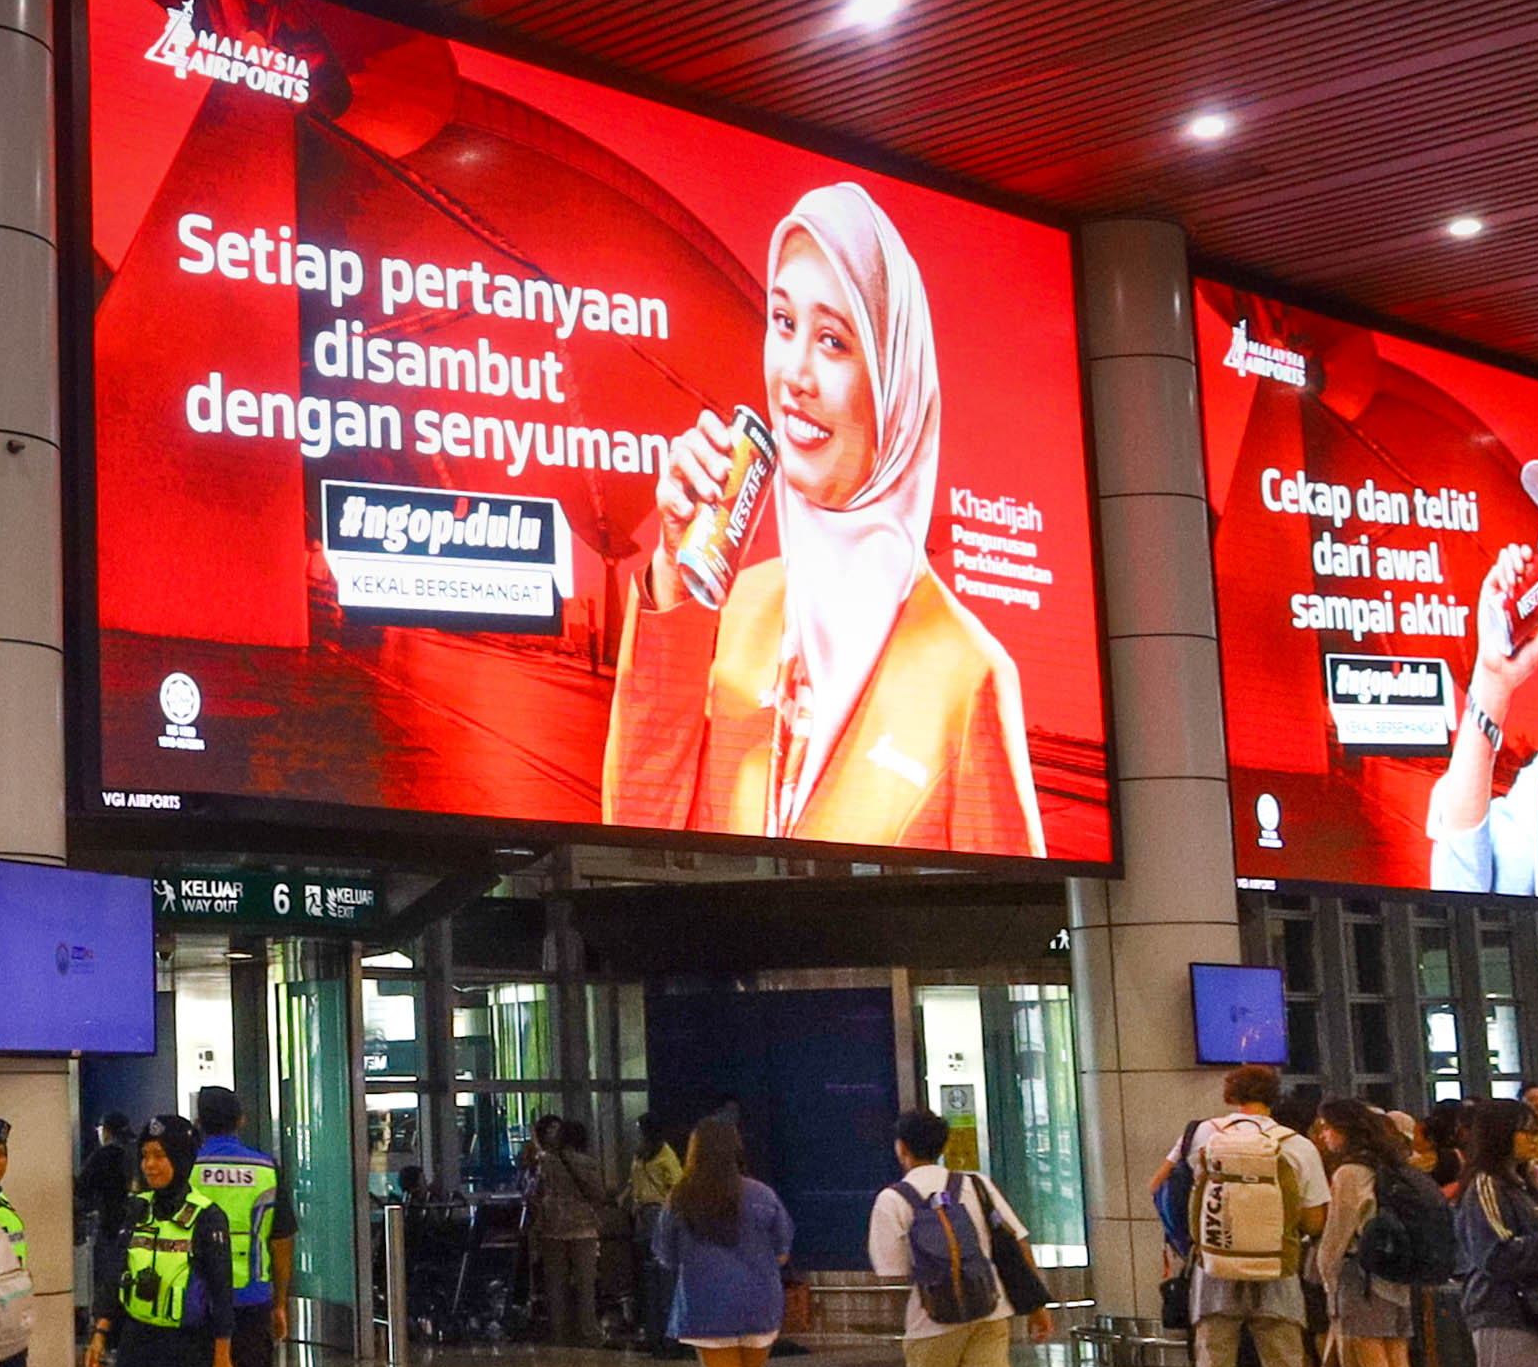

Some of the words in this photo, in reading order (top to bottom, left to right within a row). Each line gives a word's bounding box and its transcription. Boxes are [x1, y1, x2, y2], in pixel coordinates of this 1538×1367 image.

[187, 50, 310, 104] AIRPORTS
[198, 29, 310, 79] MALAYSIA
[177, 212, 364, 307] Setiap
[380, 255, 669, 340] pertanyaan
[313, 320, 565, 403] disambut
[185, 371, 402, 459] dengan
[415, 407, 671, 477] senyuman
[339, 496, 542, 553] #ngopidulu
[949, 486, 1043, 534] Khadijah
[1260, 467, 1352, 528] Cekap
[1356, 479, 1410, 525] dan
[1413, 488, 1480, 532] teliti
[1313, 531, 1372, 578] dari
[1376, 541, 1444, 584] awal
[351, 574, 410, 597] KEKAL
[414, 578, 543, 604] BERSEMANGAT
[1290, 590, 1395, 642] sampai
[1400, 592, 1470, 637] akhir
[127, 793, 182, 810] AIRPORTS
[180, 880, 244, 898] KELUAR
[272, 883, 291, 915] 6
[336, 887, 375, 906] KELUAR
[181, 898, 213, 913] WAY
[213, 899, 239, 914] OUT
[336, 905, 356, 919] EXIT
[202, 1168, 254, 1185] POLIS
